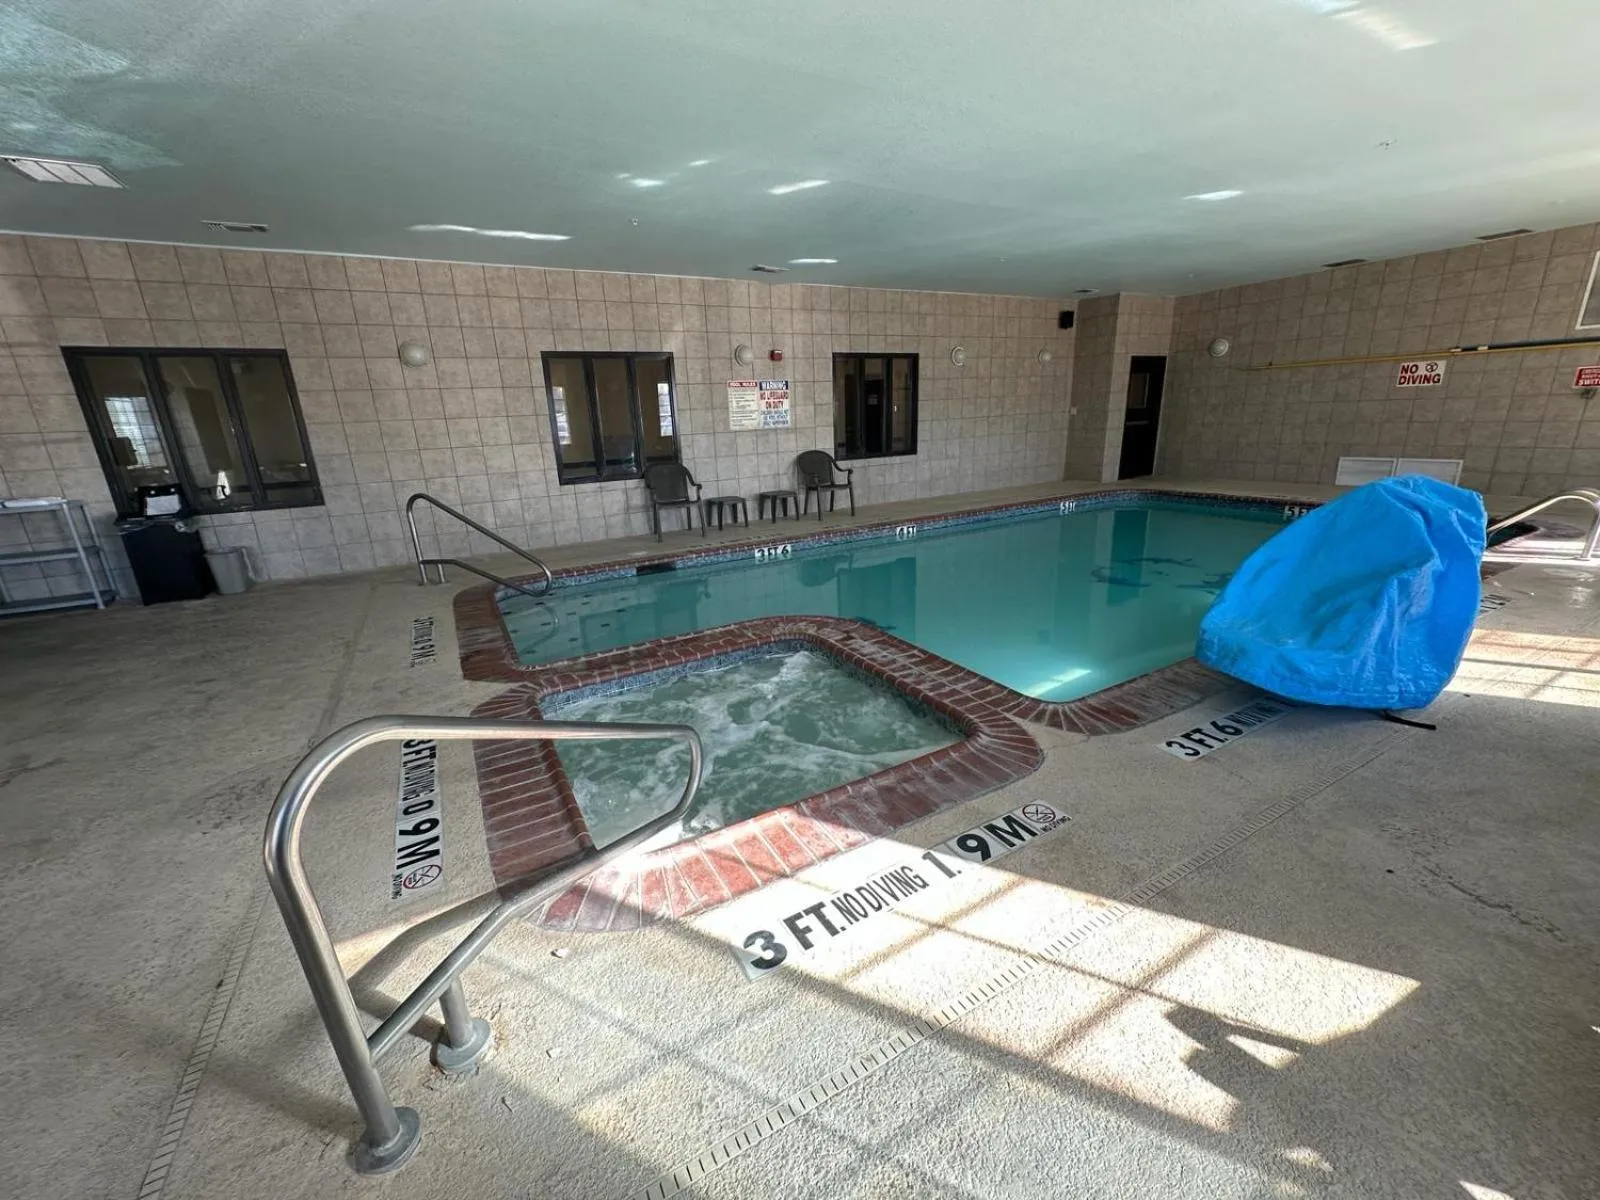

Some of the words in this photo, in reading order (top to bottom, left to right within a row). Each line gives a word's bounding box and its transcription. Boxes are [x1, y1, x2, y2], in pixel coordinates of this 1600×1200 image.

[1400, 364, 1419, 374] NO
[1399, 374, 1441, 385] DIVING
[757, 548, 766, 562] 3
[768, 546, 779, 560] FT
[781, 545, 790, 558] 6
[1210, 720, 1244, 736] 6
[403, 738, 435, 748] 3
[1180, 728, 1229, 749] FT.
[1166, 741, 1201, 757] 3
[743, 930, 788, 970] 3
[783, 902, 847, 951] FT.
[830, 892, 869, 926] NO
[855, 865, 930, 913] DIVING
